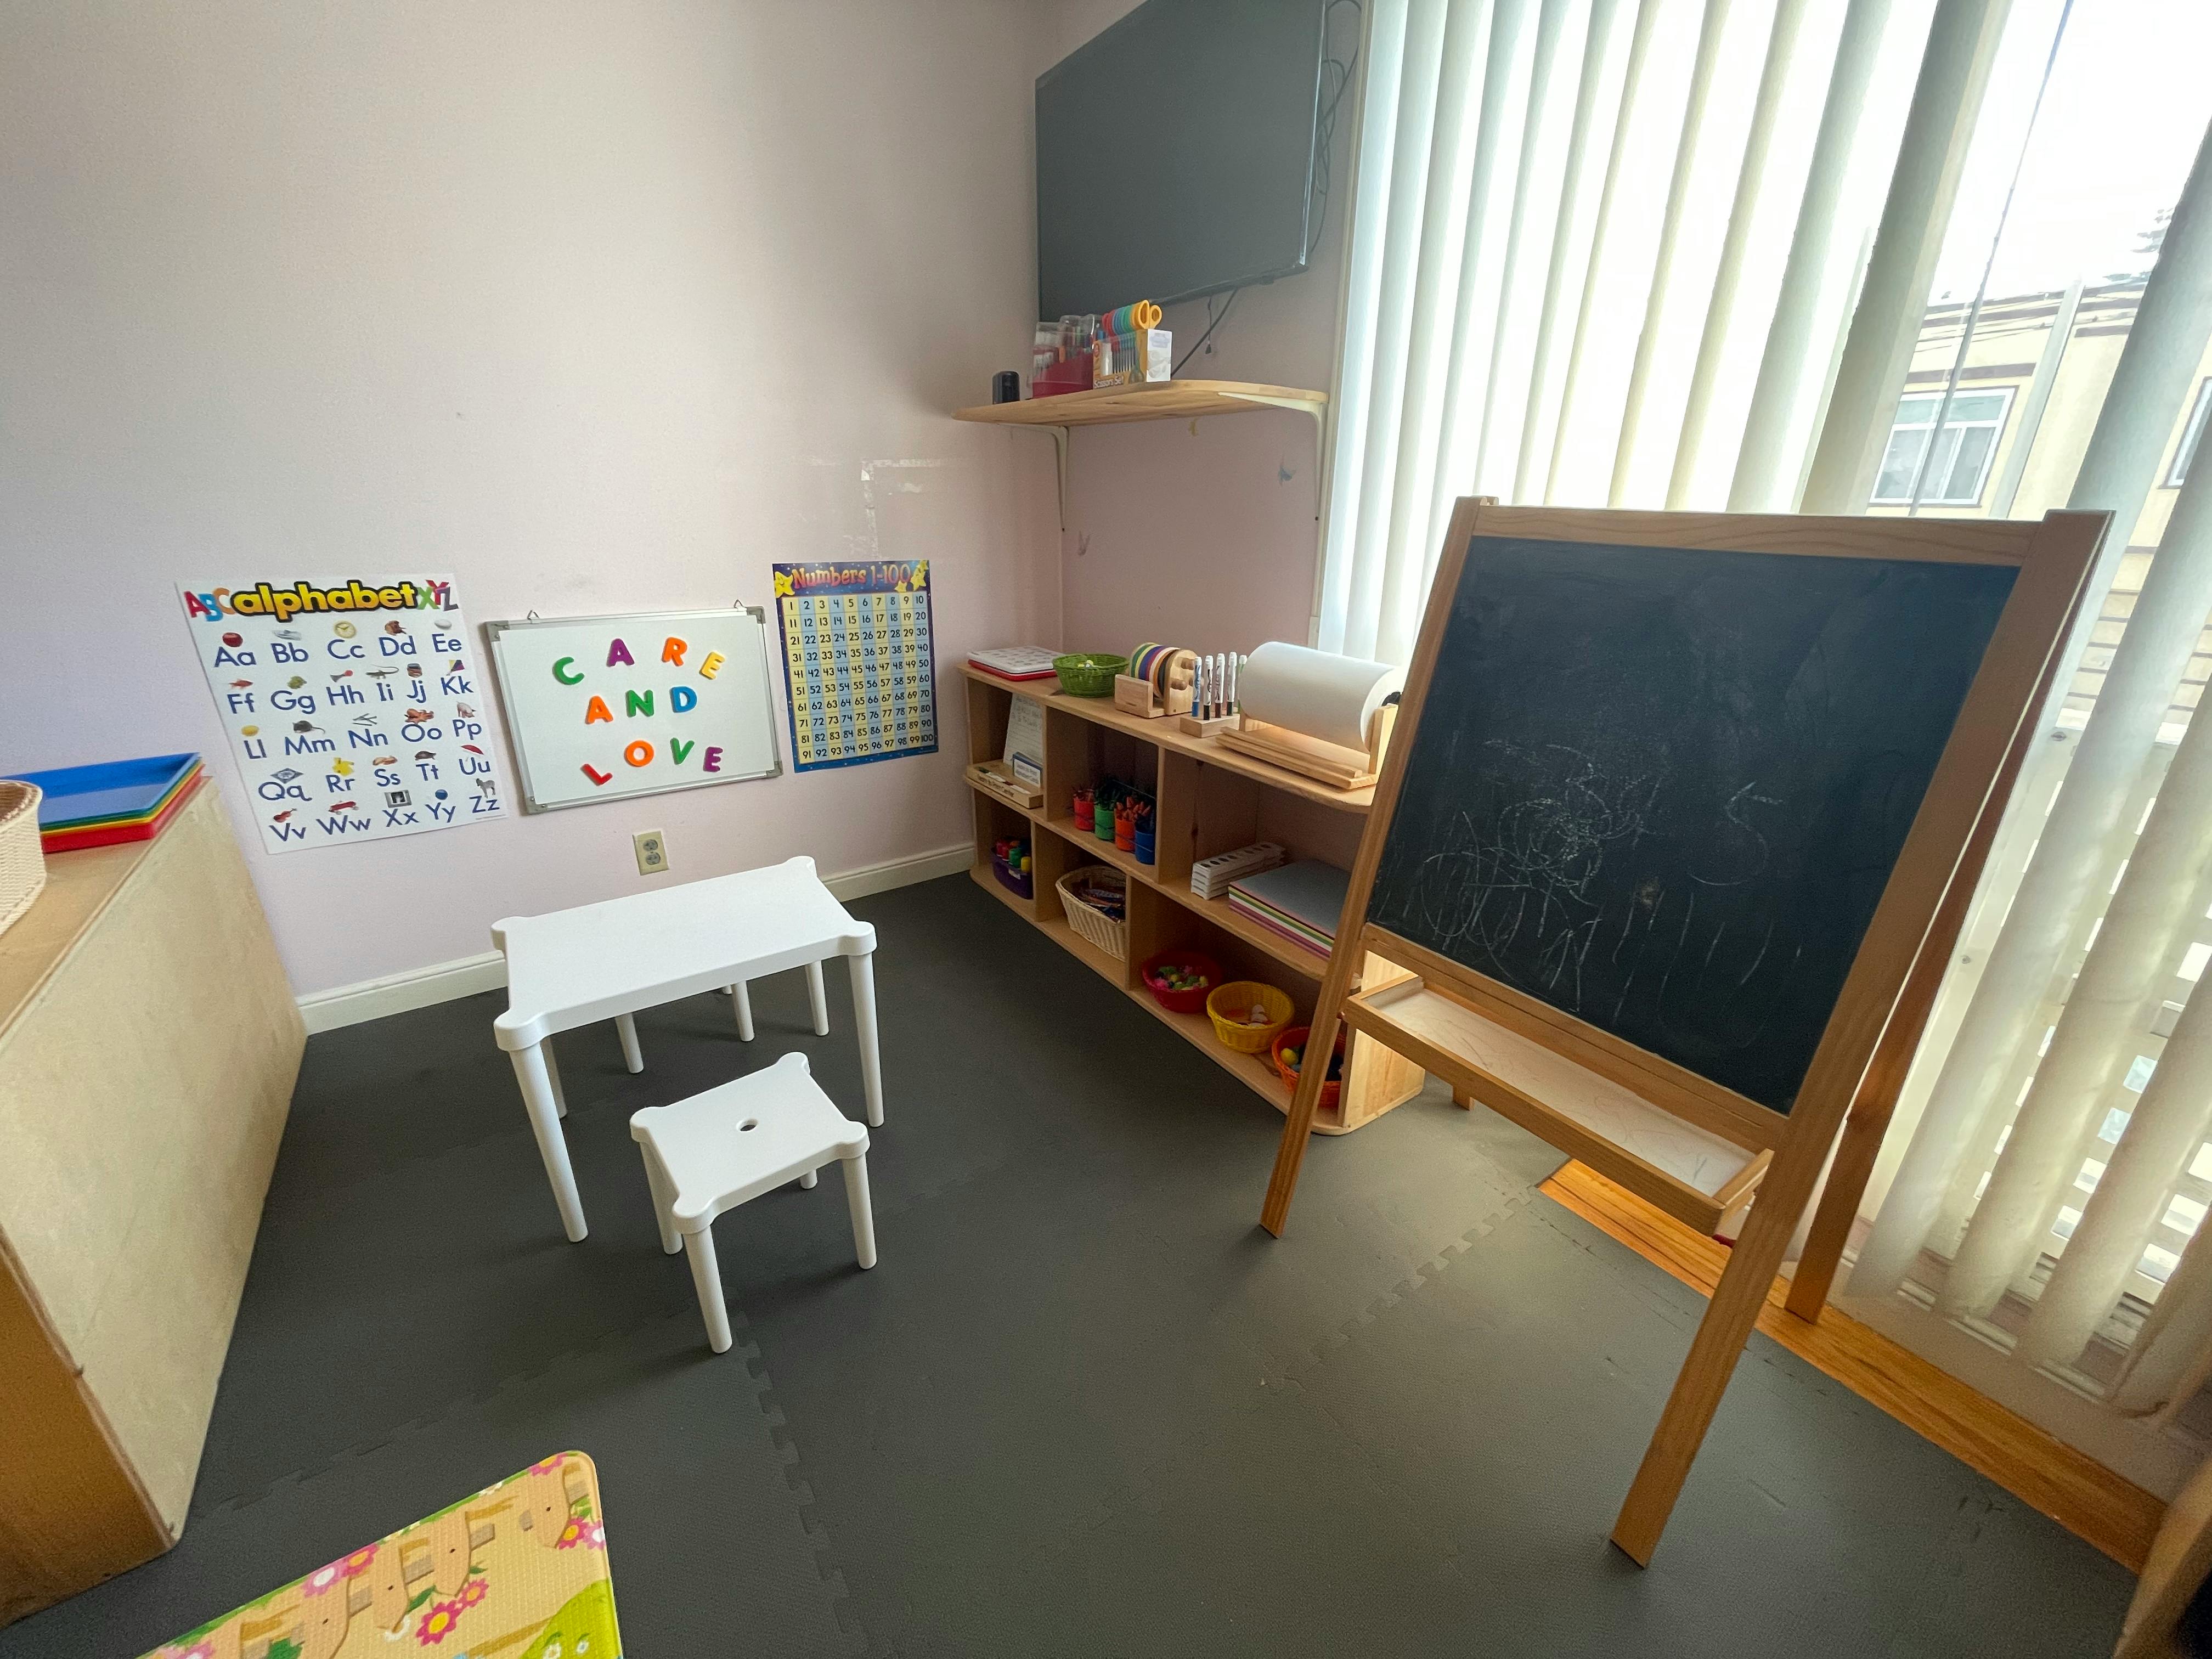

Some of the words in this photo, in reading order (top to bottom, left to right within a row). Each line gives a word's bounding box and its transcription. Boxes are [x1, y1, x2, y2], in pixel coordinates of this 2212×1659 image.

[793, 566, 866, 589] Numbers
[871, 564, 911, 584] 1-100
[184, 588, 235, 622] ABC
[229, 580, 419, 622] alphabet
[417, 579, 459, 611] XYZ
[789, 602, 793, 610] 1
[804, 601, 810, 610] 2
[820, 600, 825, 608] 3
[833, 600, 839, 608] 4
[849, 599, 854, 607] 5
[877, 597, 881, 606] 7
[891, 597, 895, 605] 8
[790, 619, 797, 628] 11
[804, 618, 813, 627] 12
[820, 617, 828, 625] 13
[834, 617, 842, 625] 14
[849, 616, 856, 624] 15
[862, 615, 871, 623] 16
[891, 613, 898, 622] 18
[904, 612, 911, 620] 19
[916, 612, 926, 620] 20
[791, 636, 799, 645] 21
[805, 635, 816, 644] 22
[820, 634, 831, 643] 23
[834, 634, 845, 642] 24
[849, 632, 859, 641] 25
[862, 631, 873, 640] 26
[877, 630, 887, 639] 27
[890, 629, 900, 638] 28
[904, 629, 913, 637] 29
[917, 628, 927, 636] 30
[213, 646, 257, 668] Aa
[270, 642, 309, 663] Bb
[327, 639, 365, 659] Cc
[378, 635, 417, 657] Dd
[432, 633, 462, 653] Ee
[552, 637, 726, 685] CARE
[793, 653, 802, 662] 31
[807, 652, 818, 661] 32
[822, 651, 833, 659] 33
[836, 650, 847, 658] 34
[851, 648, 861, 657] 35
[864, 648, 875, 656] 36
[878, 647, 888, 655] 37
[892, 646, 902, 654] 38
[905, 645, 915, 653] 39
[794, 670, 803, 678] 41
[808, 669, 820, 677] 42
[823, 668, 834, 676] 43
[837, 666, 848, 675] 44
[851, 665, 862, 673] 45
[879, 663, 889, 671] 47
[893, 662, 903, 670] 48
[919, 659, 929, 667] 50
[227, 692, 255, 714] Ff
[270, 690, 316, 715] Gg
[326, 685, 365, 706] Hh
[377, 682, 394, 702] Ii
[407, 680, 427, 703] Jj
[441, 675, 473, 696] Kk
[797, 687, 805, 695] 51
[810, 685, 821, 694] 52
[825, 684, 836, 692] 53
[839, 682, 850, 691] 54
[854, 681, 864, 690] 55
[867, 680, 877, 688] 56
[881, 679, 890, 687] 57
[894, 677, 904, 685] 58
[907, 676, 916, 684] 59
[919, 674, 929, 682] 60
[585, 686, 697, 725] AND
[798, 703, 806, 711] 61
[812, 702, 822, 710] 62
[827, 700, 837, 708] 63
[841, 698, 851, 707] 64
[868, 695, 878, 704] 66
[882, 694, 891, 702] 67
[895, 692, 905, 701] 68
[920, 690, 929, 698] 70
[799, 719, 808, 727] 71
[813, 718, 824, 726] 72
[828, 716, 839, 725] 73
[842, 714, 852, 723] 74
[856, 713, 866, 721] 75
[870, 711, 879, 719] 76
[882, 709, 892, 718] 77
[909, 706, 918, 714] 79
[921, 704, 930, 713] 80
[244, 740, 267, 759] Ll
[284, 735, 336, 755] Mm
[347, 728, 388, 749] Nn
[401, 724, 442, 742] Oo
[452, 719, 482, 741] Pp
[802, 735, 809, 743] 81
[815, 733, 826, 742] 82
[830, 732, 840, 740] 83
[843, 730, 854, 738] 84
[857, 728, 867, 736] 85
[871, 726, 880, 735] 86
[897, 723, 906, 731] 88
[909, 721, 918, 729] 89
[581, 737, 723, 786] LOVE
[803, 751, 811, 759] 91
[816, 749, 827, 757] 92
[844, 745, 855, 753] 94
[859, 743, 868, 752] 95
[258, 781, 311, 802] Qq
[325, 774, 354, 793] Rr
[374, 768, 401, 787] Ss
[415, 763, 439, 781] Tt
[459, 757, 491, 775] Uu
[269, 823, 306, 842] Vv
[317, 815, 370, 834] Ww
[382, 808, 419, 826] Xx
[425, 802, 456, 823] Yy
[469, 795, 500, 814] Zz
